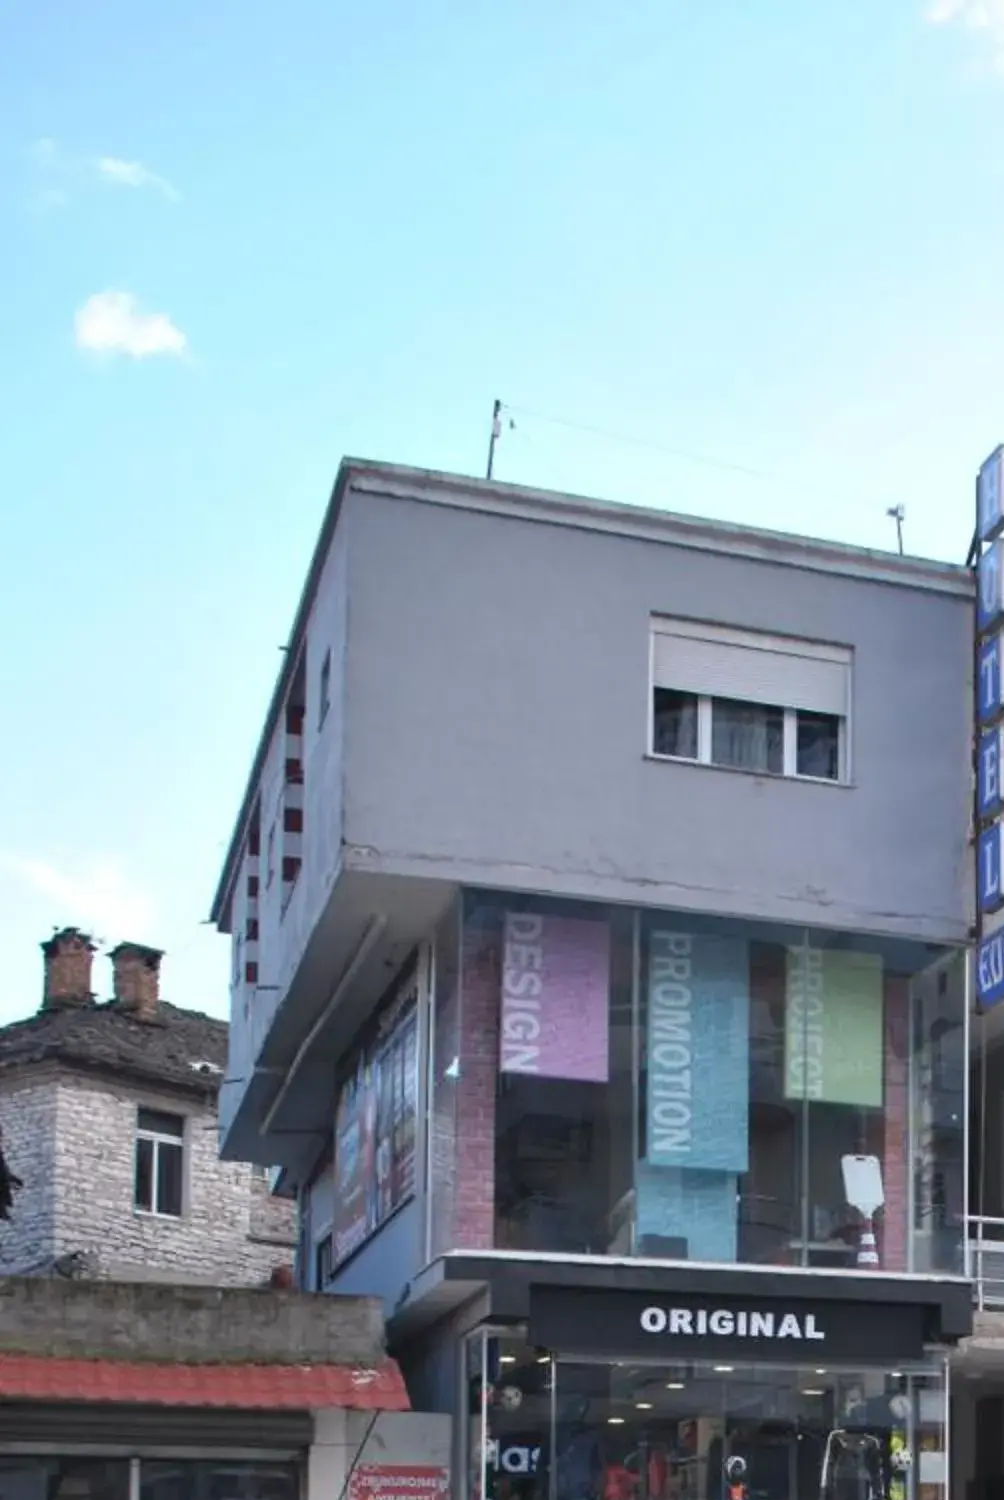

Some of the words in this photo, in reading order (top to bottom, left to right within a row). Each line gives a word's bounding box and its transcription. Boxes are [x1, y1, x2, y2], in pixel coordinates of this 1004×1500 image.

[982, 459, 999, 898] HOTEL
[502, 911, 543, 1073] DESIGN
[652, 930, 694, 1154] PROMOTION
[640, 1307, 824, 1341] ORIGINAL
